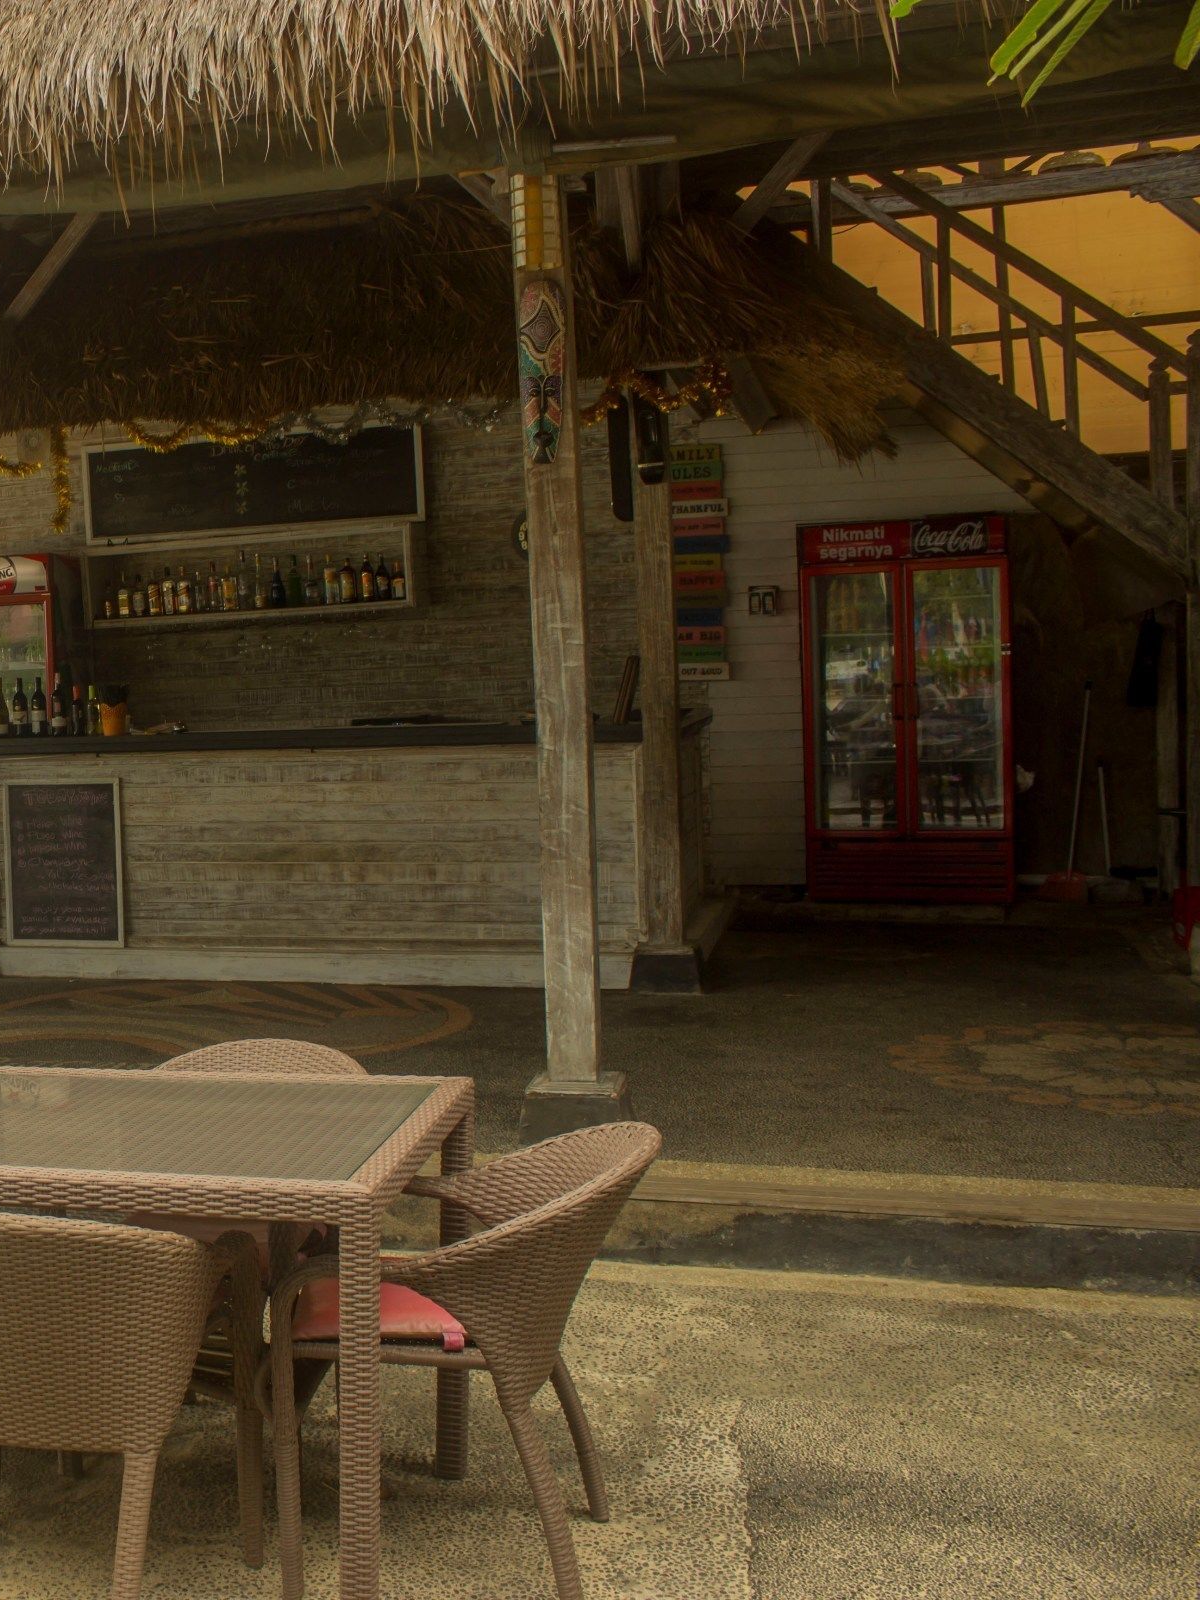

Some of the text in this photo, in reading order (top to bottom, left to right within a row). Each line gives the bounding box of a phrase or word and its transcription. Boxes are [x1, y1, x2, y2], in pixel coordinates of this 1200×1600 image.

[670, 448, 715, 461] MILY
[672, 466, 711, 480] ULES
[822, 526, 885, 543] Nikmati
[915, 520, 986, 553] Coca-Cola
[820, 543, 893, 561] segarnya
[681, 666, 723, 676] OUT LOUD
